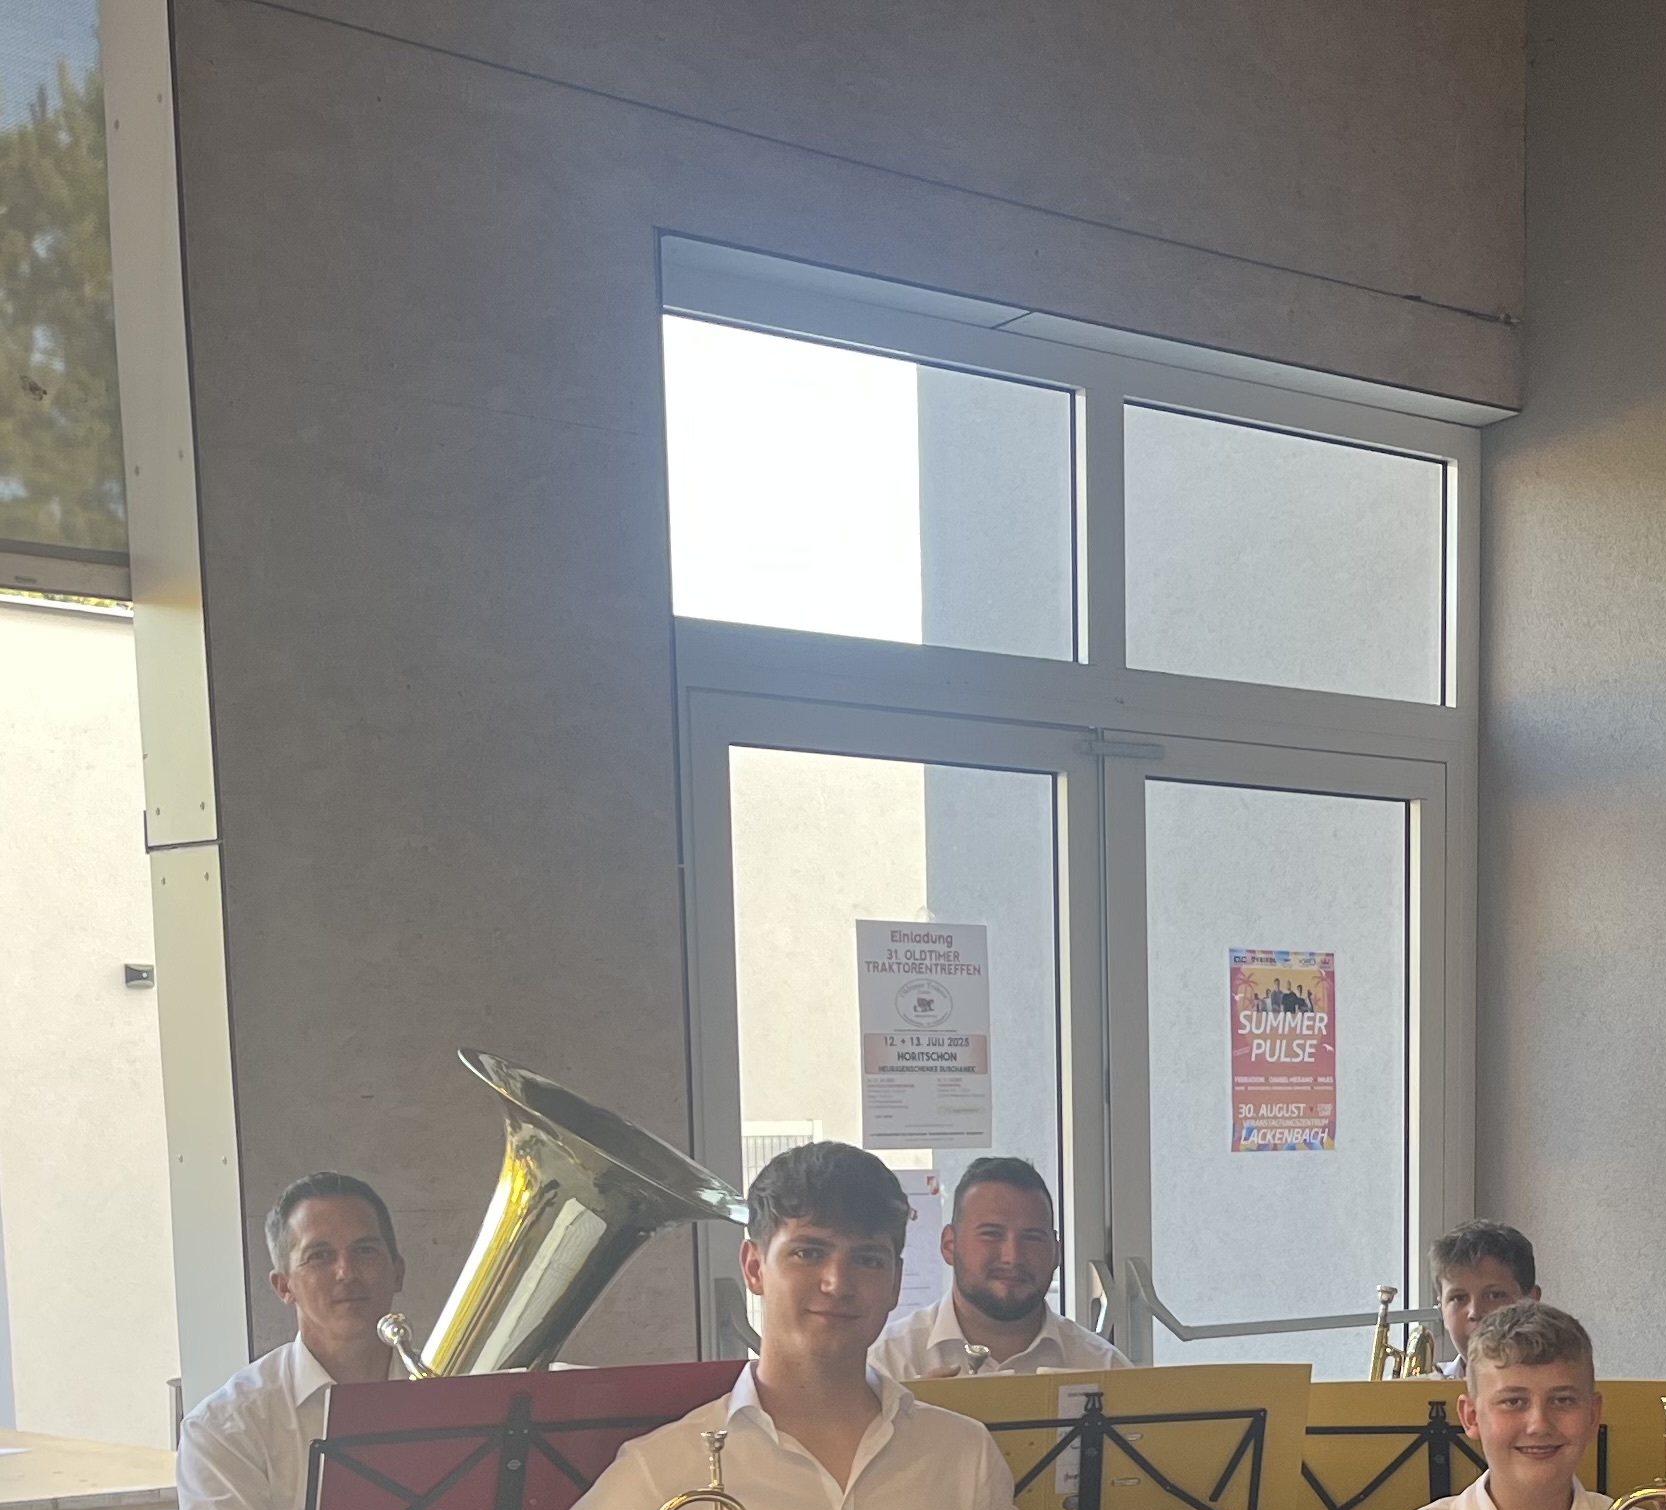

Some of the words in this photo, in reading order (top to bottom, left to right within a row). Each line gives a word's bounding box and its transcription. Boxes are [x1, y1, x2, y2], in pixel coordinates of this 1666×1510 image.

[890, 930, 953, 948] Einladung
[904, 950, 960, 962] OLDTIMER
[864, 961, 981, 976] TRAKTORENTREFFEN
[1238, 1010, 1328, 1036] SUMMER
[884, 1036, 897, 1047] 12.
[926, 1037, 945, 1047] JULI
[947, 1037, 970, 1047] 2025
[897, 1051, 957, 1062] HORITSCHON
[1250, 1038, 1318, 1063] PULSE
[1258, 1103, 1306, 1118] AUGUST
[1240, 1128, 1329, 1145] LACKENBACH
